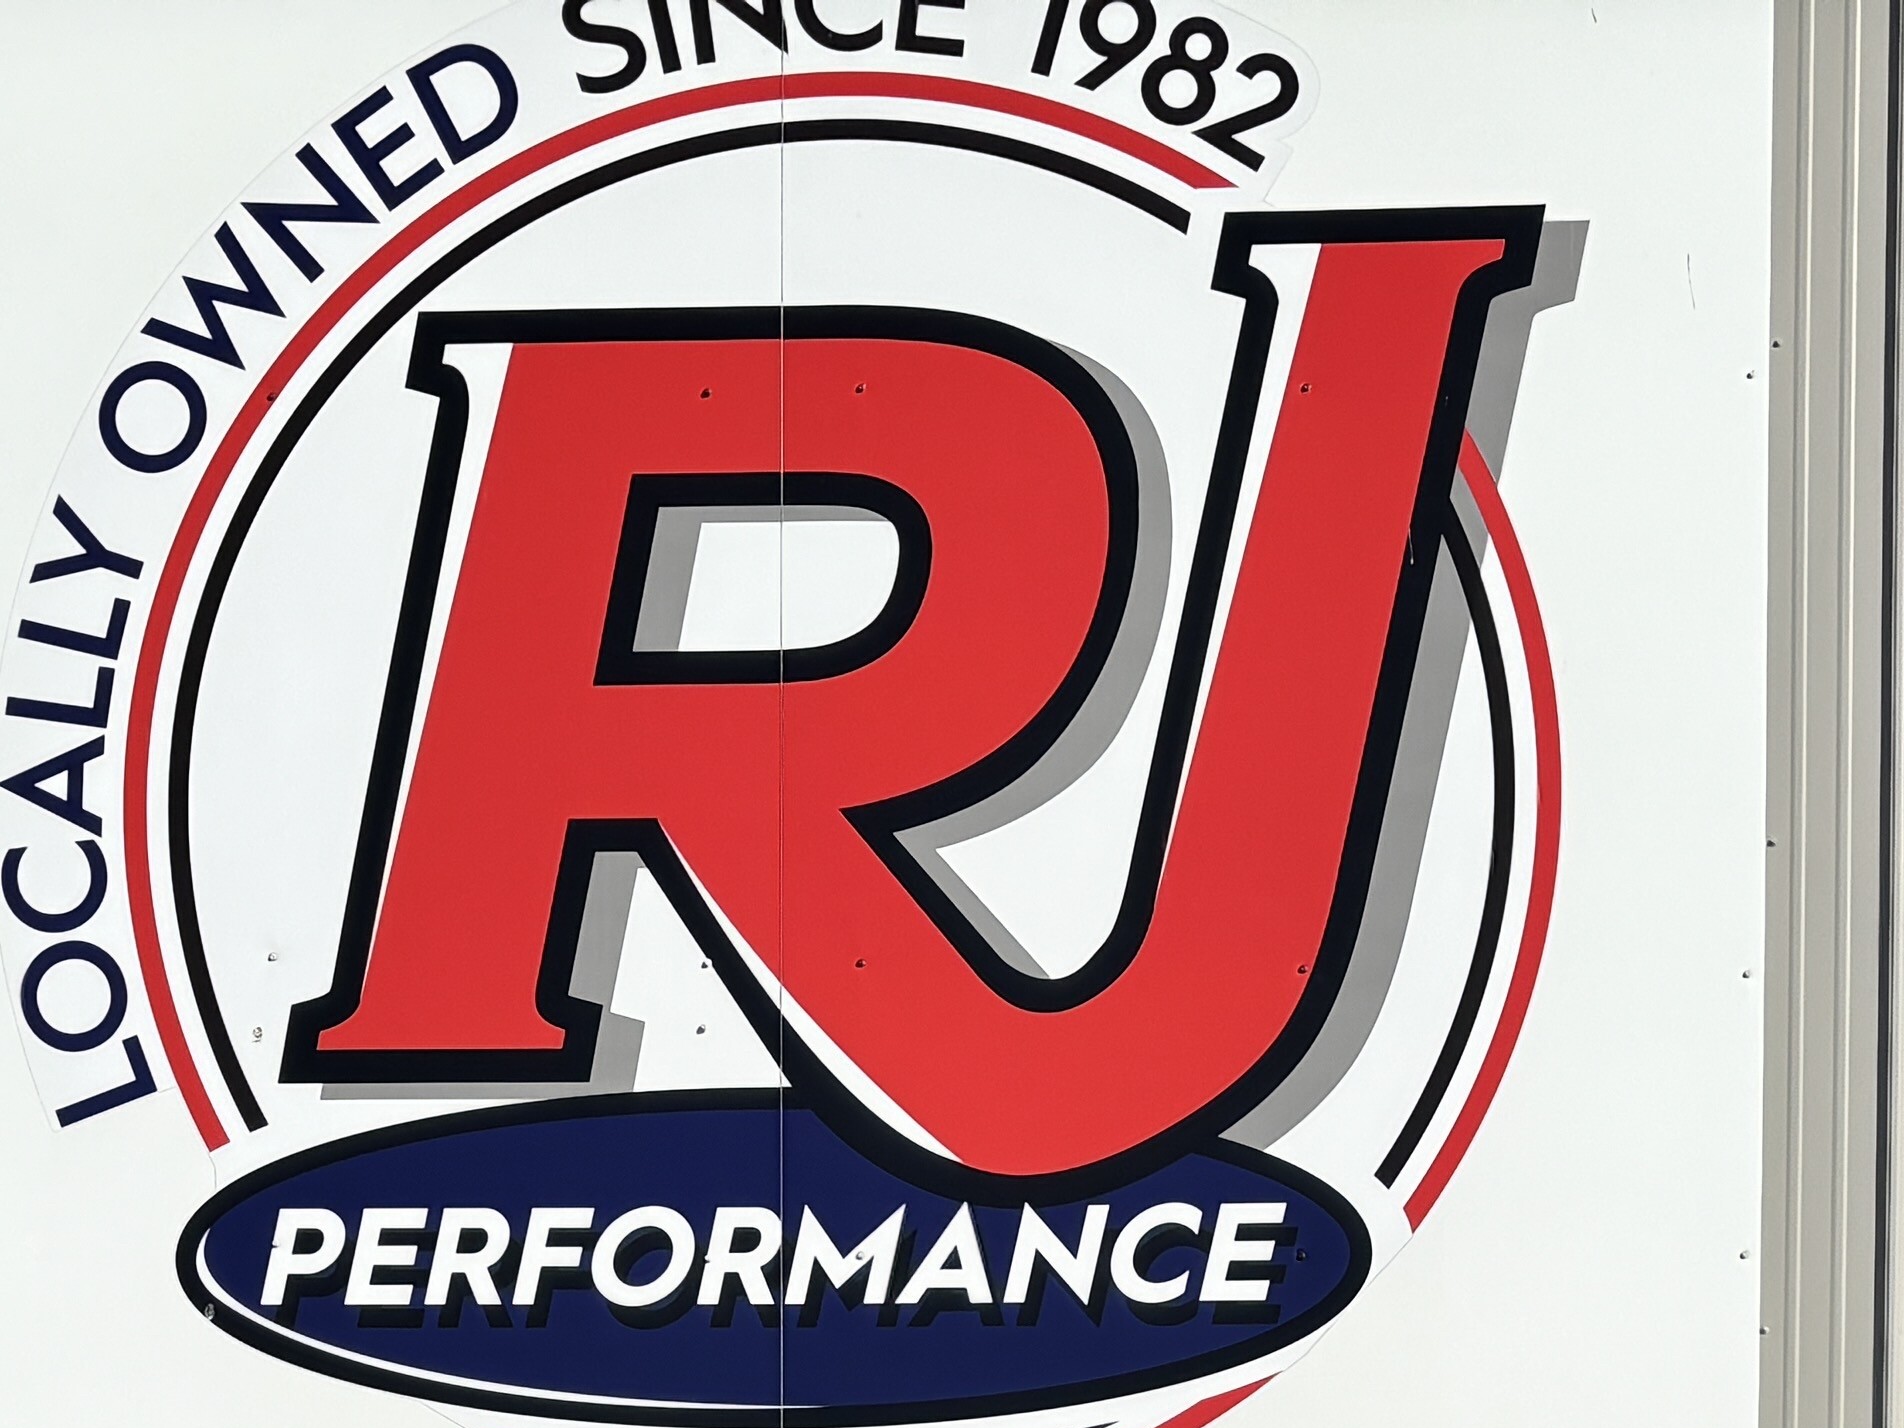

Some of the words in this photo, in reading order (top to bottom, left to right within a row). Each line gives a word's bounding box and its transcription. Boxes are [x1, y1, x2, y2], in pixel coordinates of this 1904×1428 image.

[99, 43, 519, 474] OWNED
[1030, 0, 1300, 173] 1982
[279, 203, 1546, 1207] RJ
[259, 1201, 1288, 1306] PERFORMANCE
